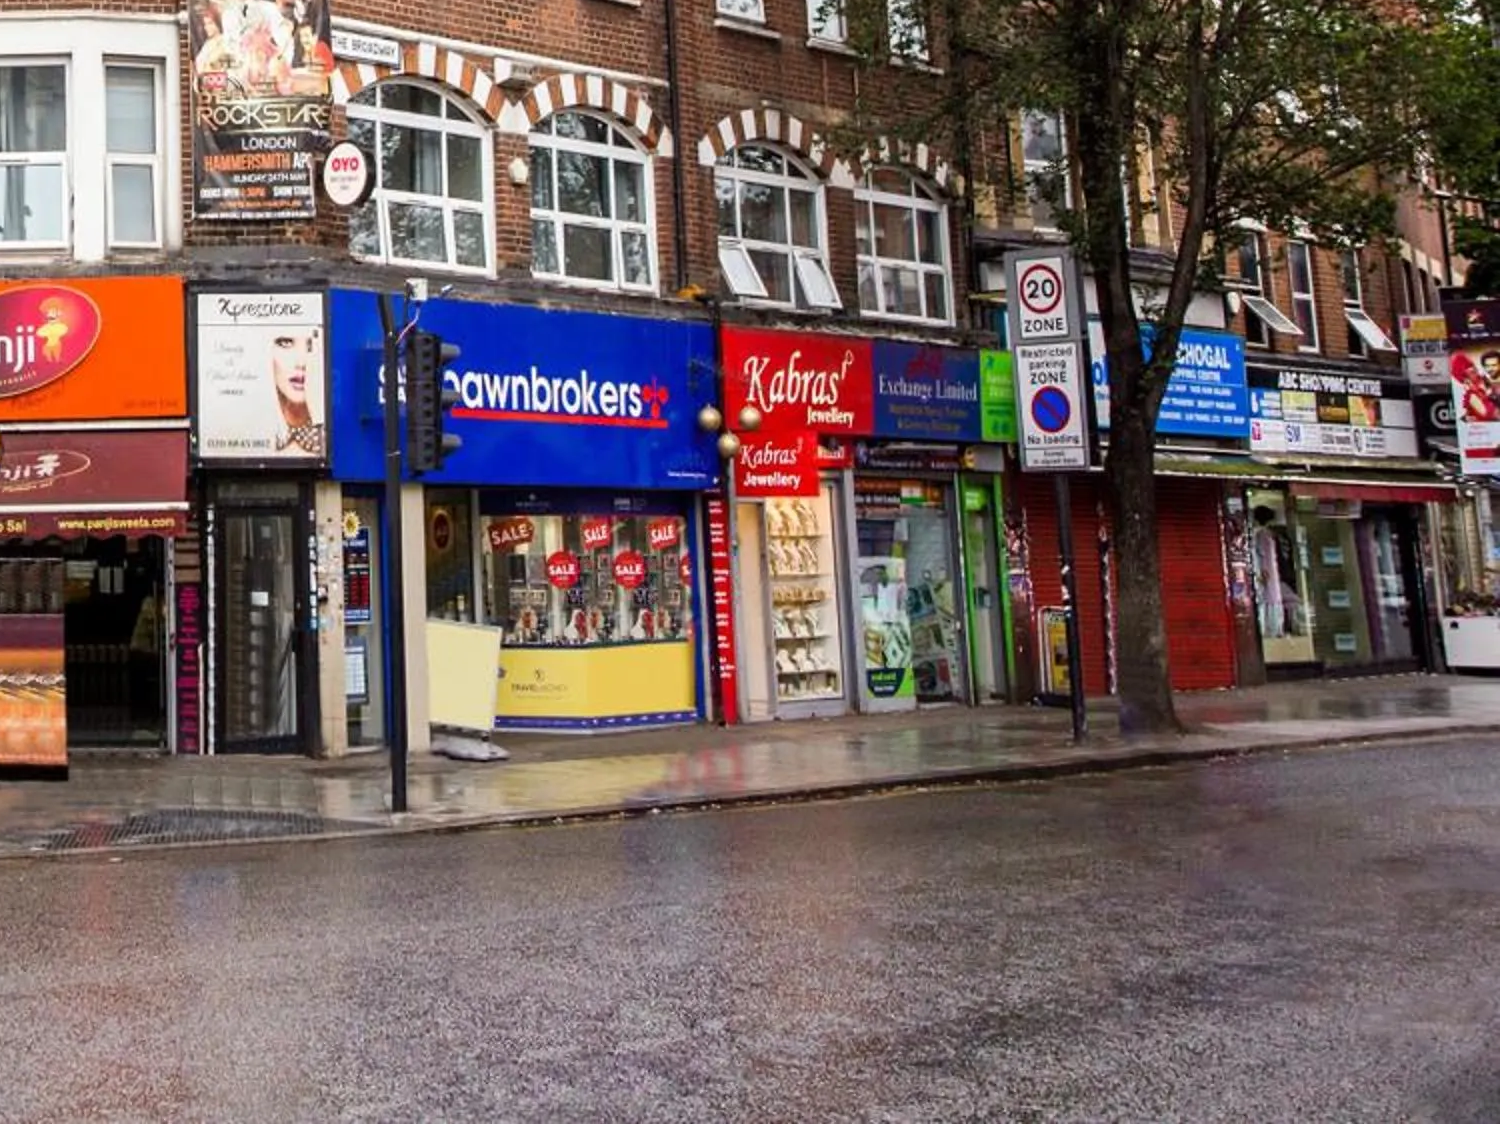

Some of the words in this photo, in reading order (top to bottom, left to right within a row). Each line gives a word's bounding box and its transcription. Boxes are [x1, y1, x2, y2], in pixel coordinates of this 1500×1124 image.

[351, 39, 395, 55] BROADWAY
[241, 136, 297, 151] LONDON
[203, 152, 291, 173] HAMMERSMITH
[332, 156, 359, 172] OYO
[1027, 278, 1055, 299] 20
[1024, 317, 1065, 333] ZONE
[1021, 346, 1073, 358] Restricted
[1029, 360, 1067, 371] parking
[1030, 371, 1068, 385] ZONE
[1278, 371, 1298, 389] ABC
[1299, 373, 1346, 394] SHOPPING
[1347, 377, 1383, 397] CENTRE
[879, 374, 933, 401] Exchange
[935, 379, 978, 402] Limited
[807, 405, 854, 428] Jewellery
[1028, 435, 1041, 445] No
[1043, 434, 1080, 445] loading
[743, 471, 801, 491] Jewellery
[491, 523, 530, 546] SALE
[584, 525, 608, 544] SALE
[651, 525, 675, 544] SALE
[548, 564, 576, 575] SALE
[615, 564, 643, 575] SALE
